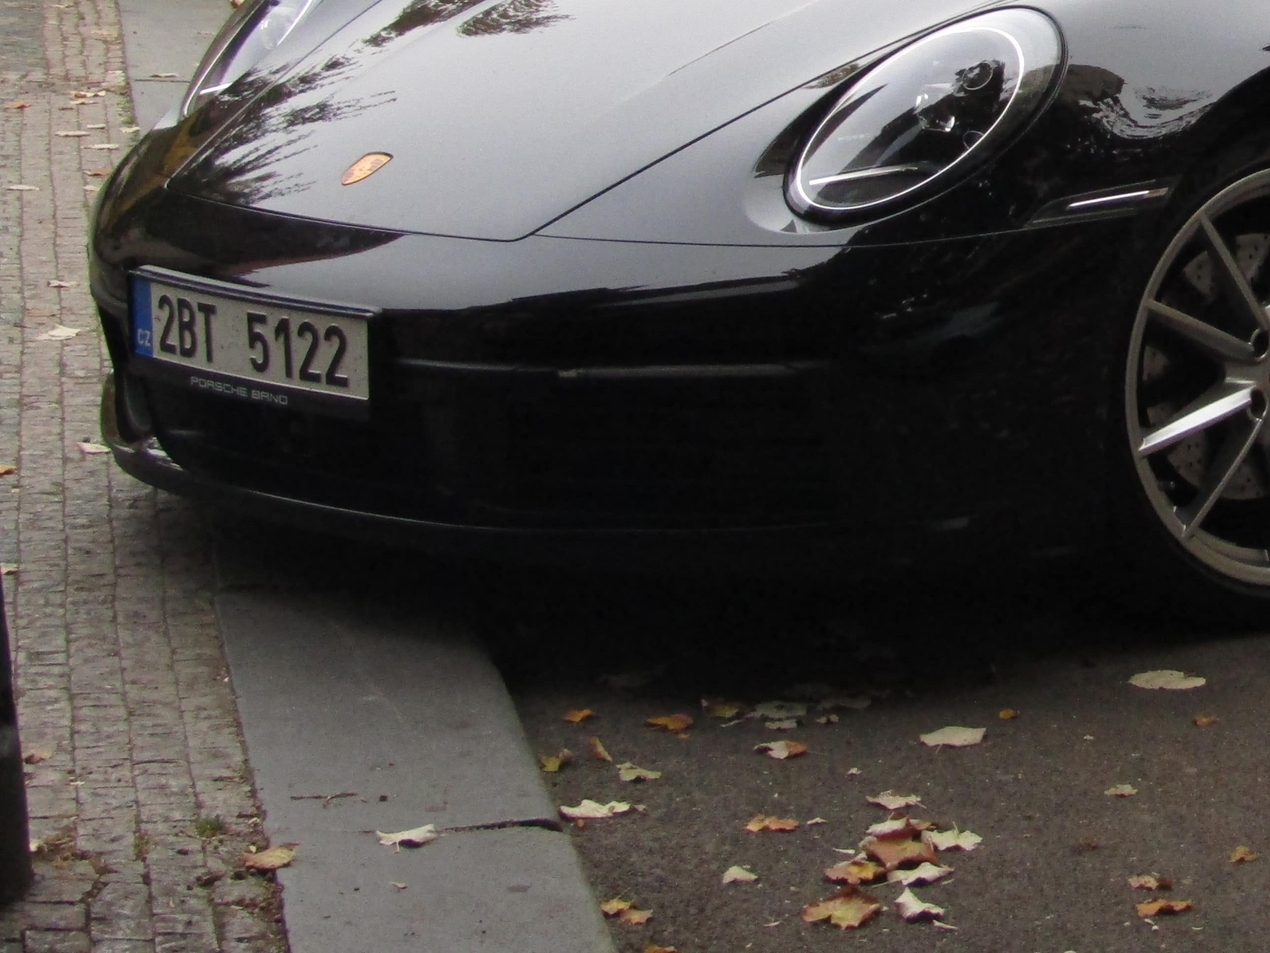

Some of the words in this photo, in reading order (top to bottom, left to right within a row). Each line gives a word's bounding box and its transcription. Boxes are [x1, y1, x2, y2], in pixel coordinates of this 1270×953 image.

[138, 328, 151, 346] CZ
[157, 293, 217, 364] 2BT
[246, 310, 349, 388] 5122
[190, 376, 249, 398] PORSCHE
[251, 391, 289, 405] BRNO
